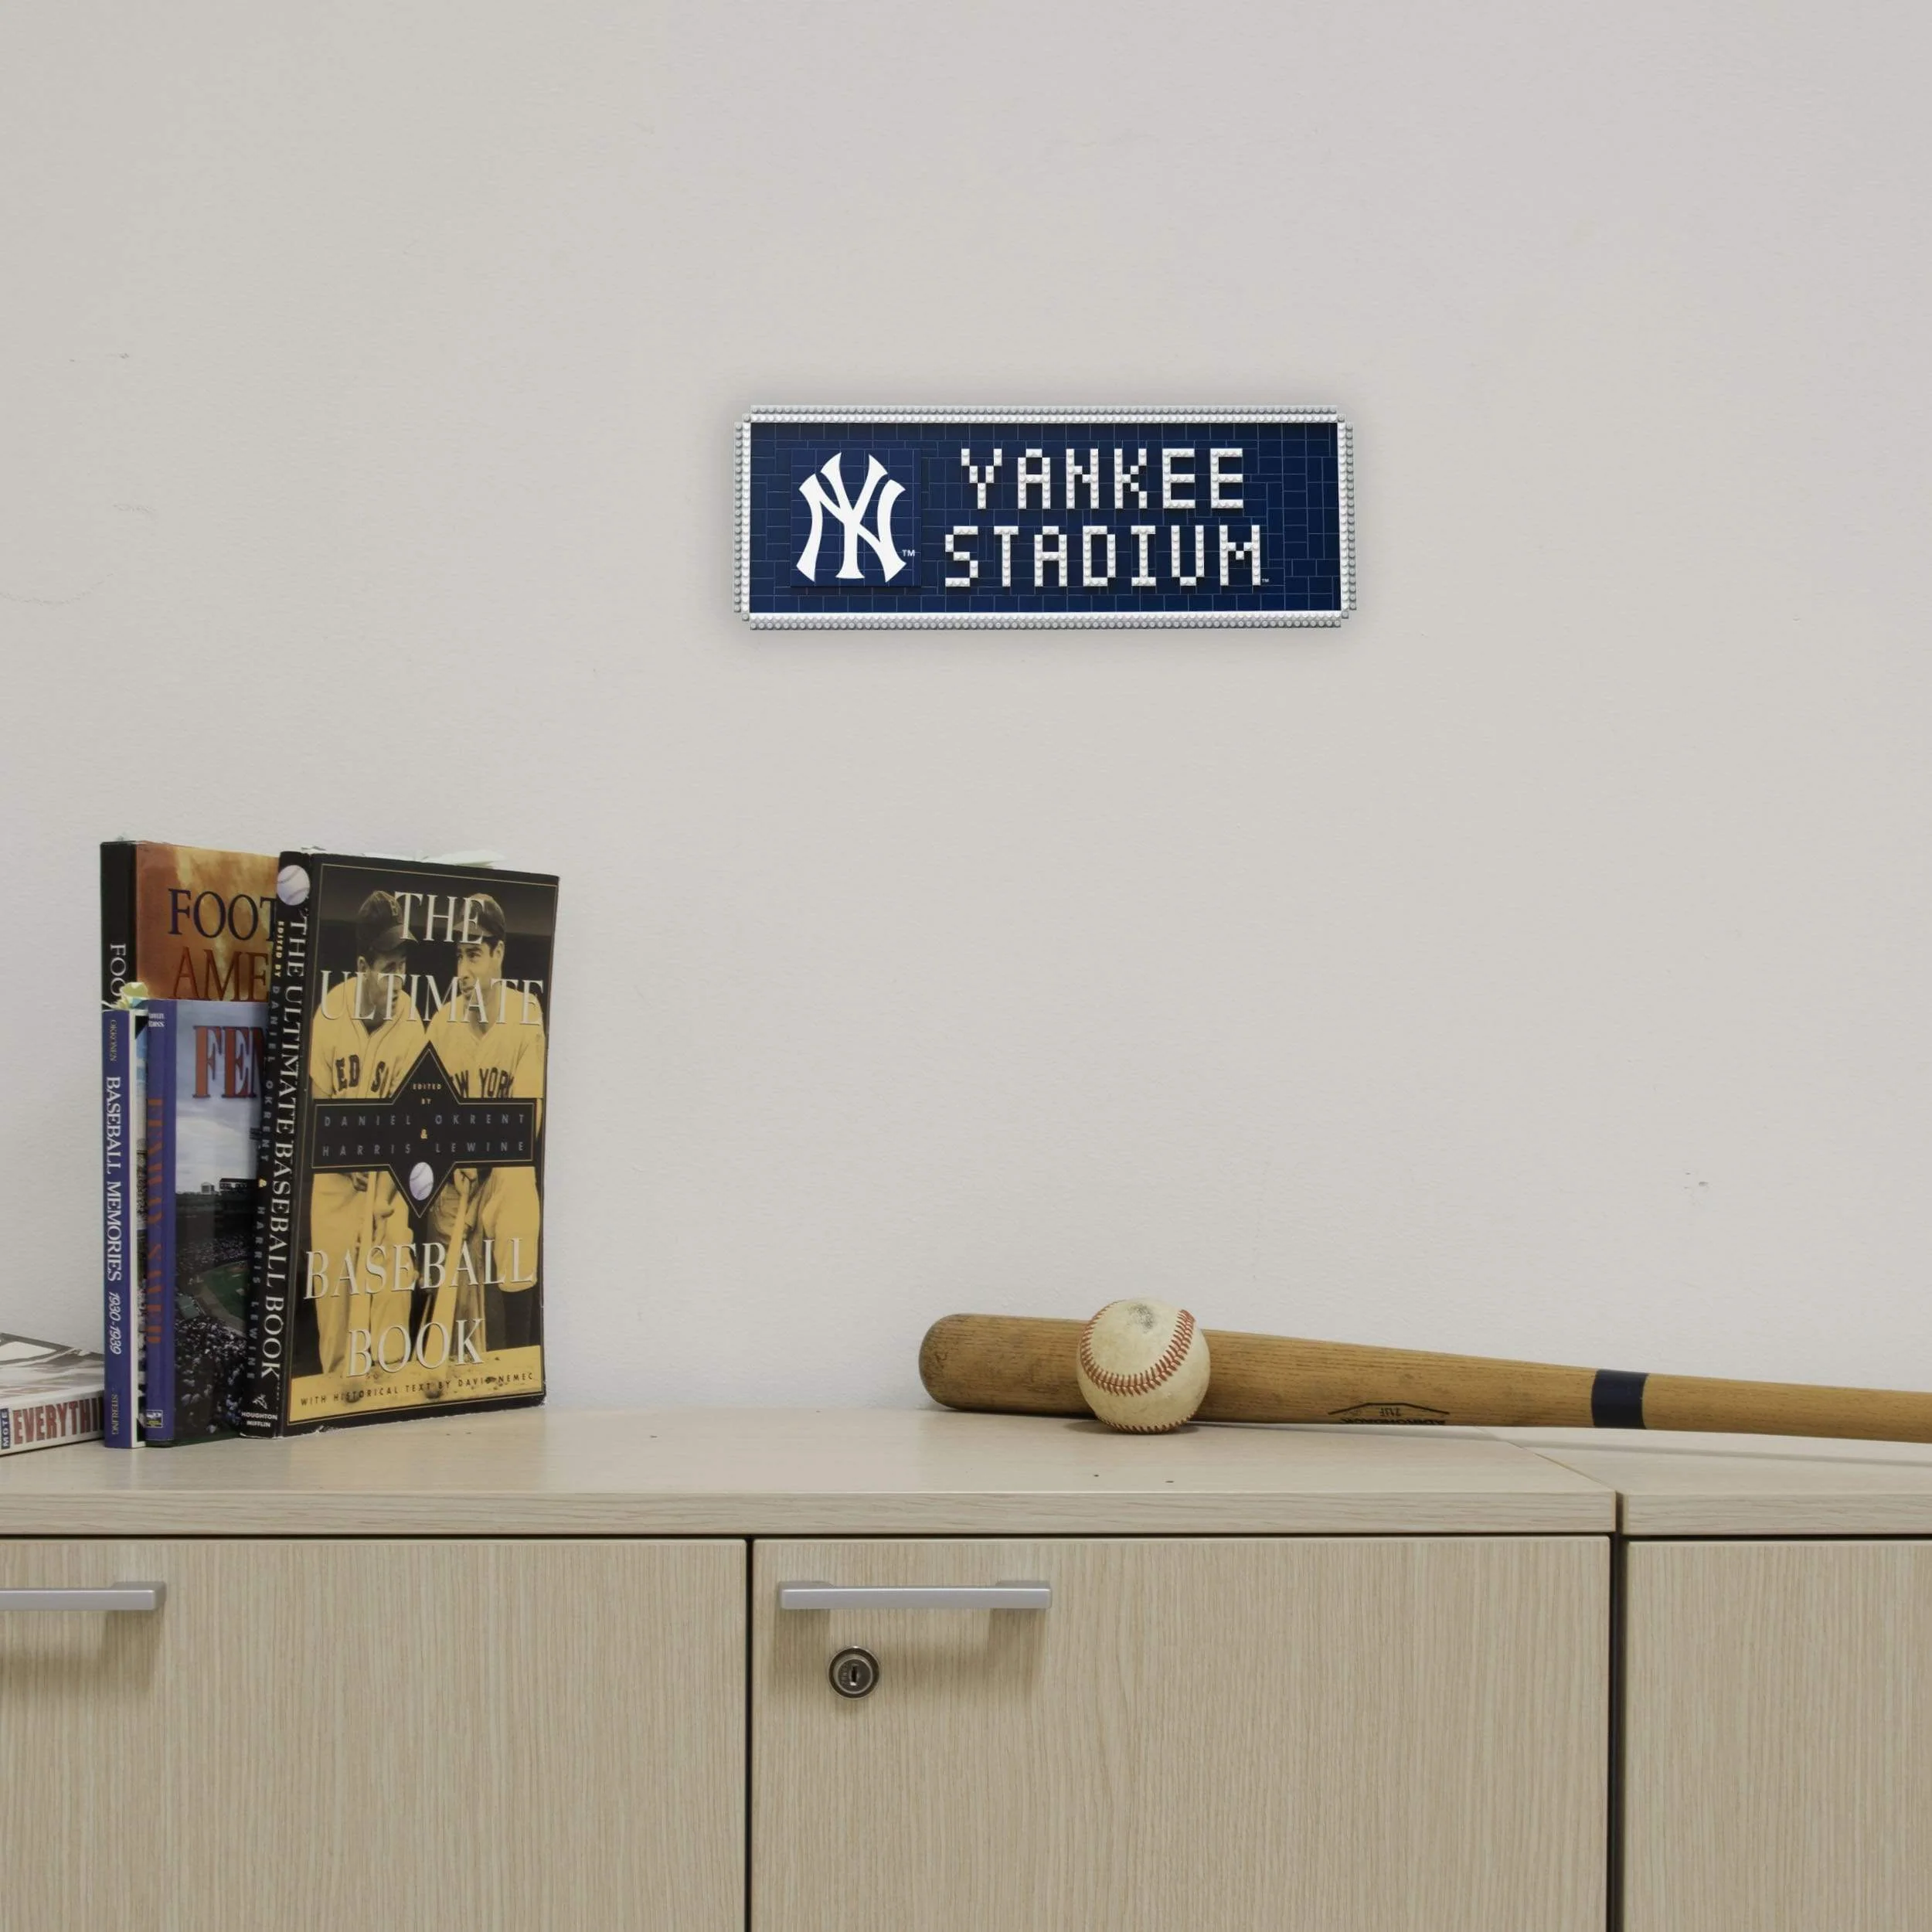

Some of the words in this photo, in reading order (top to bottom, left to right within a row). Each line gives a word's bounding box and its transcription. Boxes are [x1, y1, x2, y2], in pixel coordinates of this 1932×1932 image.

[961, 448, 1243, 509] YANKEE
[945, 526, 1261, 587] STADIUM
[276, 920, 284, 958] EDITED
[287, 917, 308, 977] THE
[394, 891, 485, 944] THE
[168, 947, 270, 1002] AME
[274, 964, 282, 978] BY
[321, 971, 543, 1026] ULTIMATE
[267, 985, 281, 1063] DANIEL
[276, 985, 303, 1134] ULTIMATE
[106, 1077, 122, 1174] BASEBALL
[261, 1080, 274, 1163] OKRENT
[323, 1145, 411, 1156] HARRIS
[435, 1142, 524, 1153] LEWINE
[325, 1117, 411, 1127] DANIEL
[435, 1114, 525, 1124] OKRENT
[420, 1129, 427, 1139] &
[258, 1179, 267, 1188] &
[106, 1181, 122, 1282] MEMORIES
[267, 1142, 294, 1287] BASEBALL
[253, 1206, 265, 1284] HARRIS
[304, 1237, 533, 1299] BASEBALL
[108, 1291, 121, 1355] 1930-1939
[247, 1301, 259, 1379] LEWINE
[260, 1295, 284, 1379] BOOK
[346, 1318, 484, 1378] BOOK
[111, 1394, 120, 1435] STERLING
[241, 1412, 278, 1420] HOUGHTON
[301, 1395, 326, 1406] WITH
[333, 1386, 398, 1402] HISTORICAL
[406, 1383, 431, 1393] TEXT
[438, 1380, 451, 1389] BY
[498, 1372, 533, 1384] NEMEC
[12, 1397, 104, 1444] EVERYTHI
